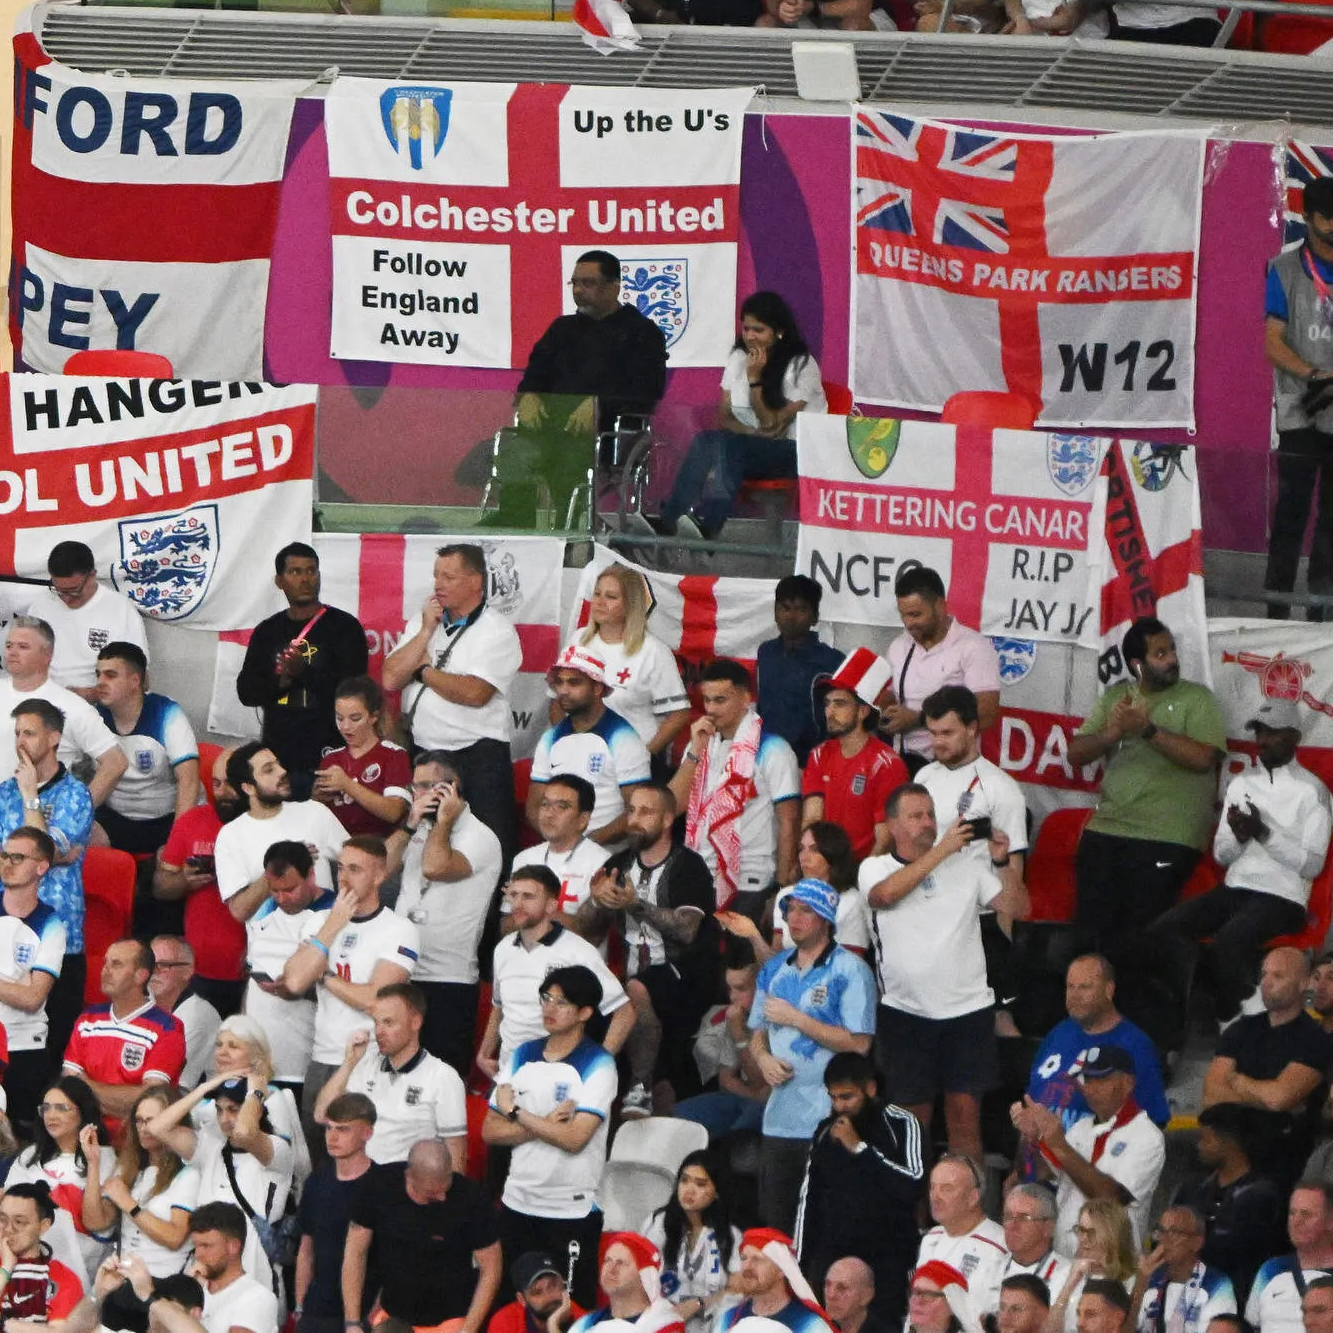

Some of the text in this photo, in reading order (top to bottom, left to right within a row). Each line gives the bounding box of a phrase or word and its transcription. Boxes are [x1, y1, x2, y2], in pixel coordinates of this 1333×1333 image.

[574, 109, 730, 138] Up the U's
[346, 190, 725, 233] Colchester United
[373, 249, 467, 277] Follow
[870, 242, 964, 283] QUEENS
[973, 262, 1050, 292] PARK
[362, 284, 478, 316] England
[380, 322, 459, 355] Away
[1058, 339, 1176, 393] W12
[76, 422, 294, 507] UNITED
[817, 488, 1085, 542] KETTERING CANAR
[1012, 548, 1074, 582] R.I.P
[1005, 598, 1059, 633] JAY
